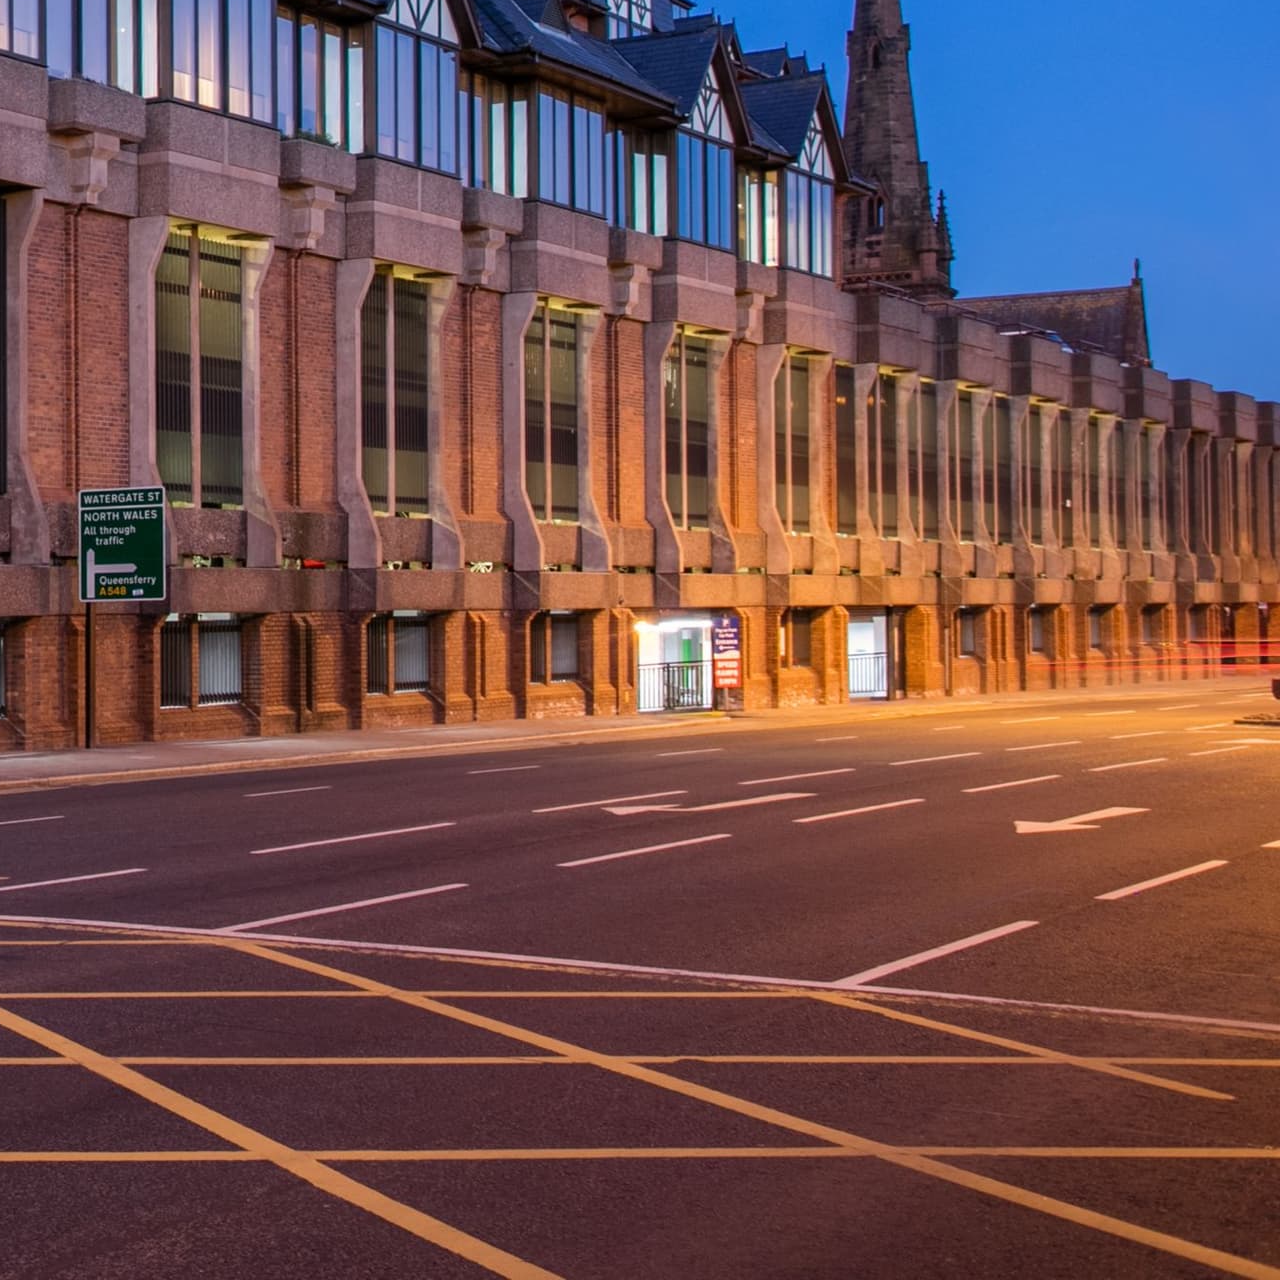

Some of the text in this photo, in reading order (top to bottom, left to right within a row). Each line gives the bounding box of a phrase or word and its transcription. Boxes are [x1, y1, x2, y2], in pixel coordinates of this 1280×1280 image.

[83, 491, 160, 504] WATERGATE ST
[83, 509, 158, 522] NORTH WALES
[83, 524, 136, 536] All through
[95, 536, 124, 545] traffic
[99, 575, 156, 586] Queensferry
[99, 586, 127, 596] A548
